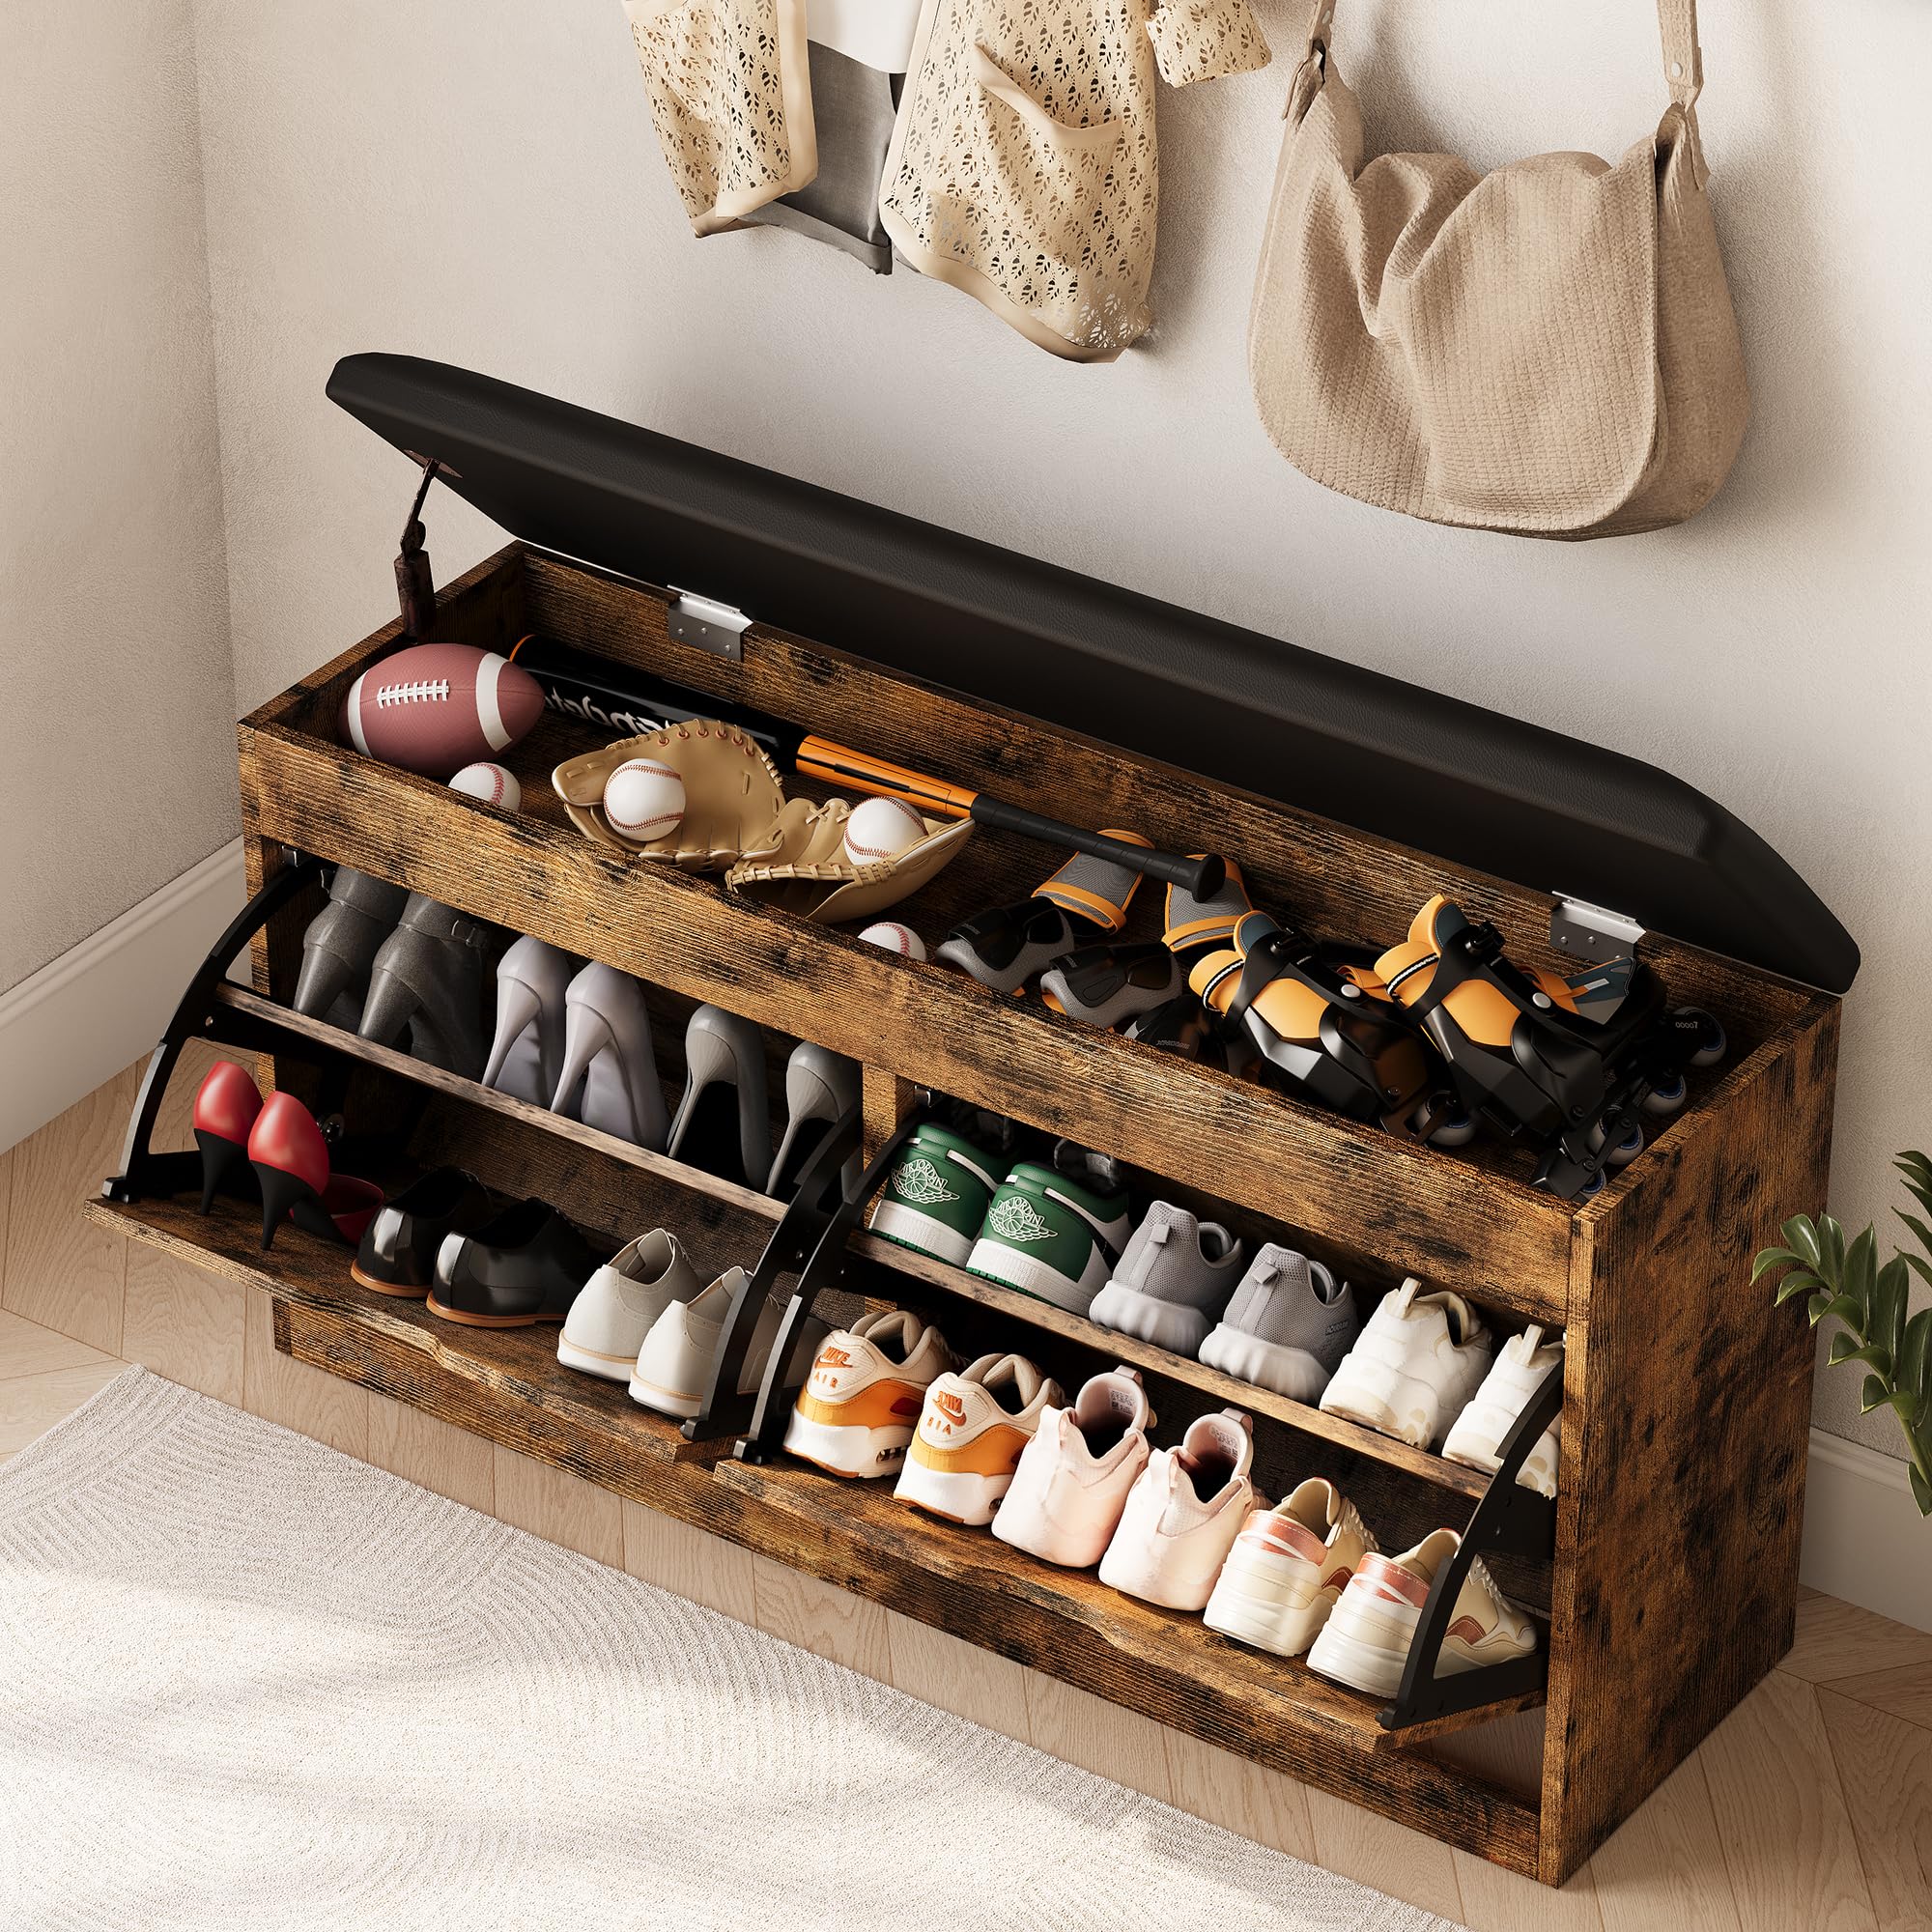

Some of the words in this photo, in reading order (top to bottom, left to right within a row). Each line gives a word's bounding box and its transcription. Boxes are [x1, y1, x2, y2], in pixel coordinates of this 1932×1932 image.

[914, 1159, 948, 1189] JORDAN
[1011, 1196, 1045, 1227] JORDAN
[823, 1346, 851, 1364] NIKE
[813, 1372, 838, 1388] AIR
